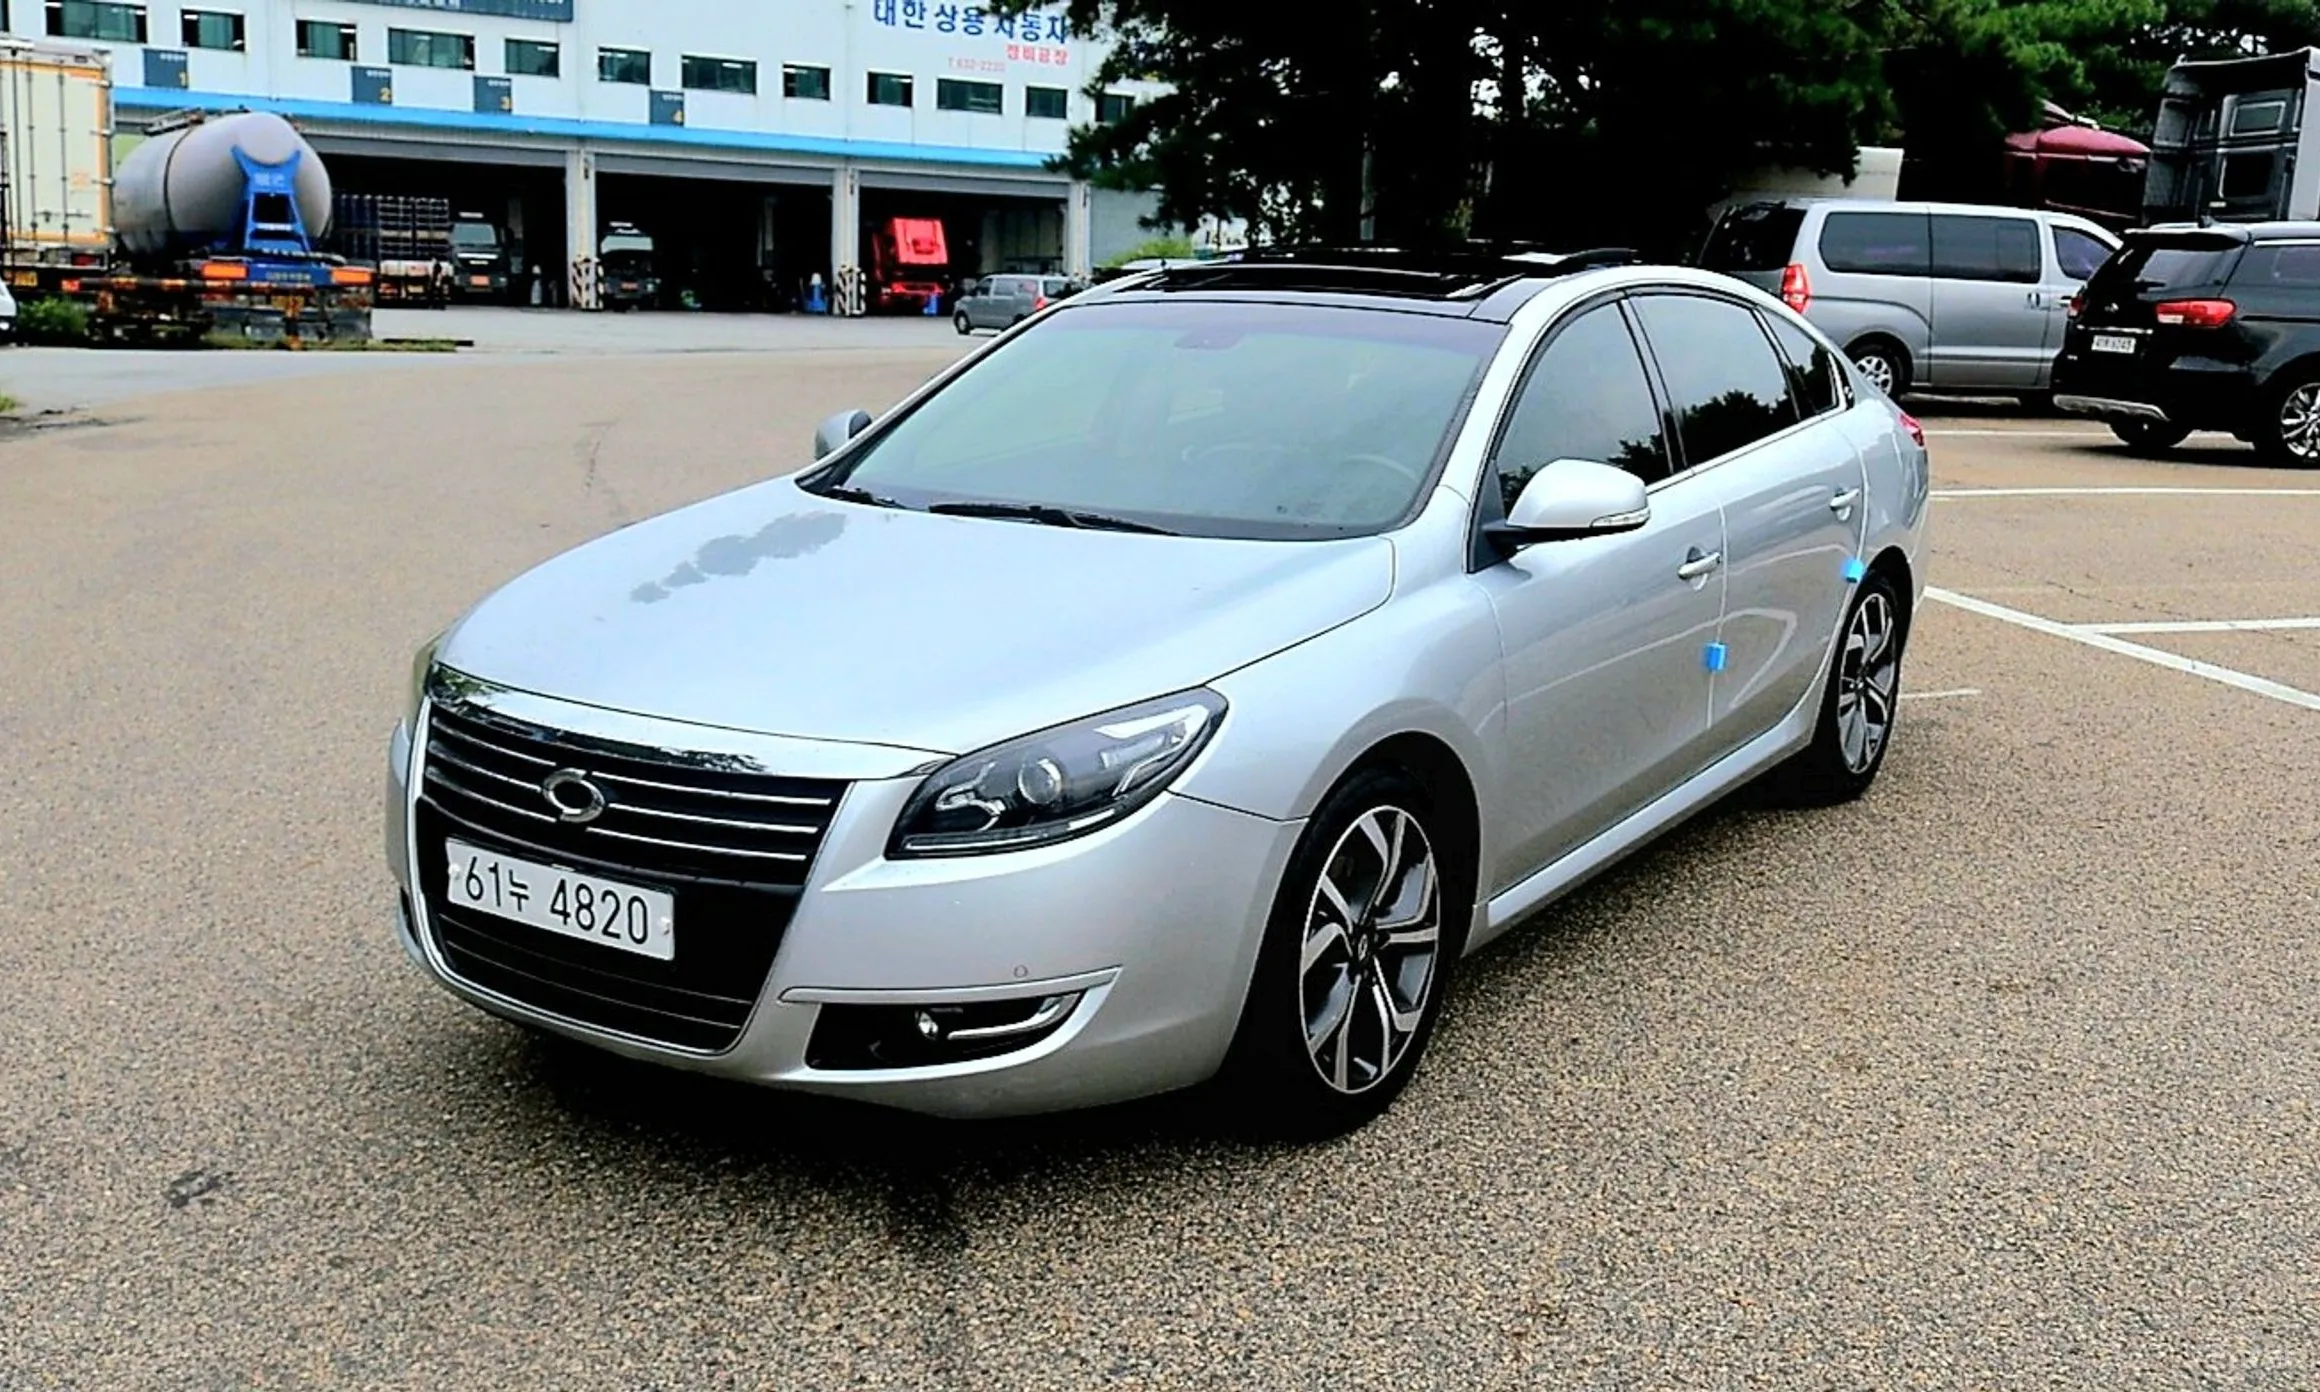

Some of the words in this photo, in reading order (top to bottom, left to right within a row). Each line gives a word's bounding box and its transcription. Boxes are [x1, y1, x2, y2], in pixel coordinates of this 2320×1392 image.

[874, 0, 927, 29] 대한
[934, 3, 985, 35] 상용
[380, 86, 391, 102] 2
[466, 856, 529, 912] 61누
[550, 879, 648, 944] 4820
